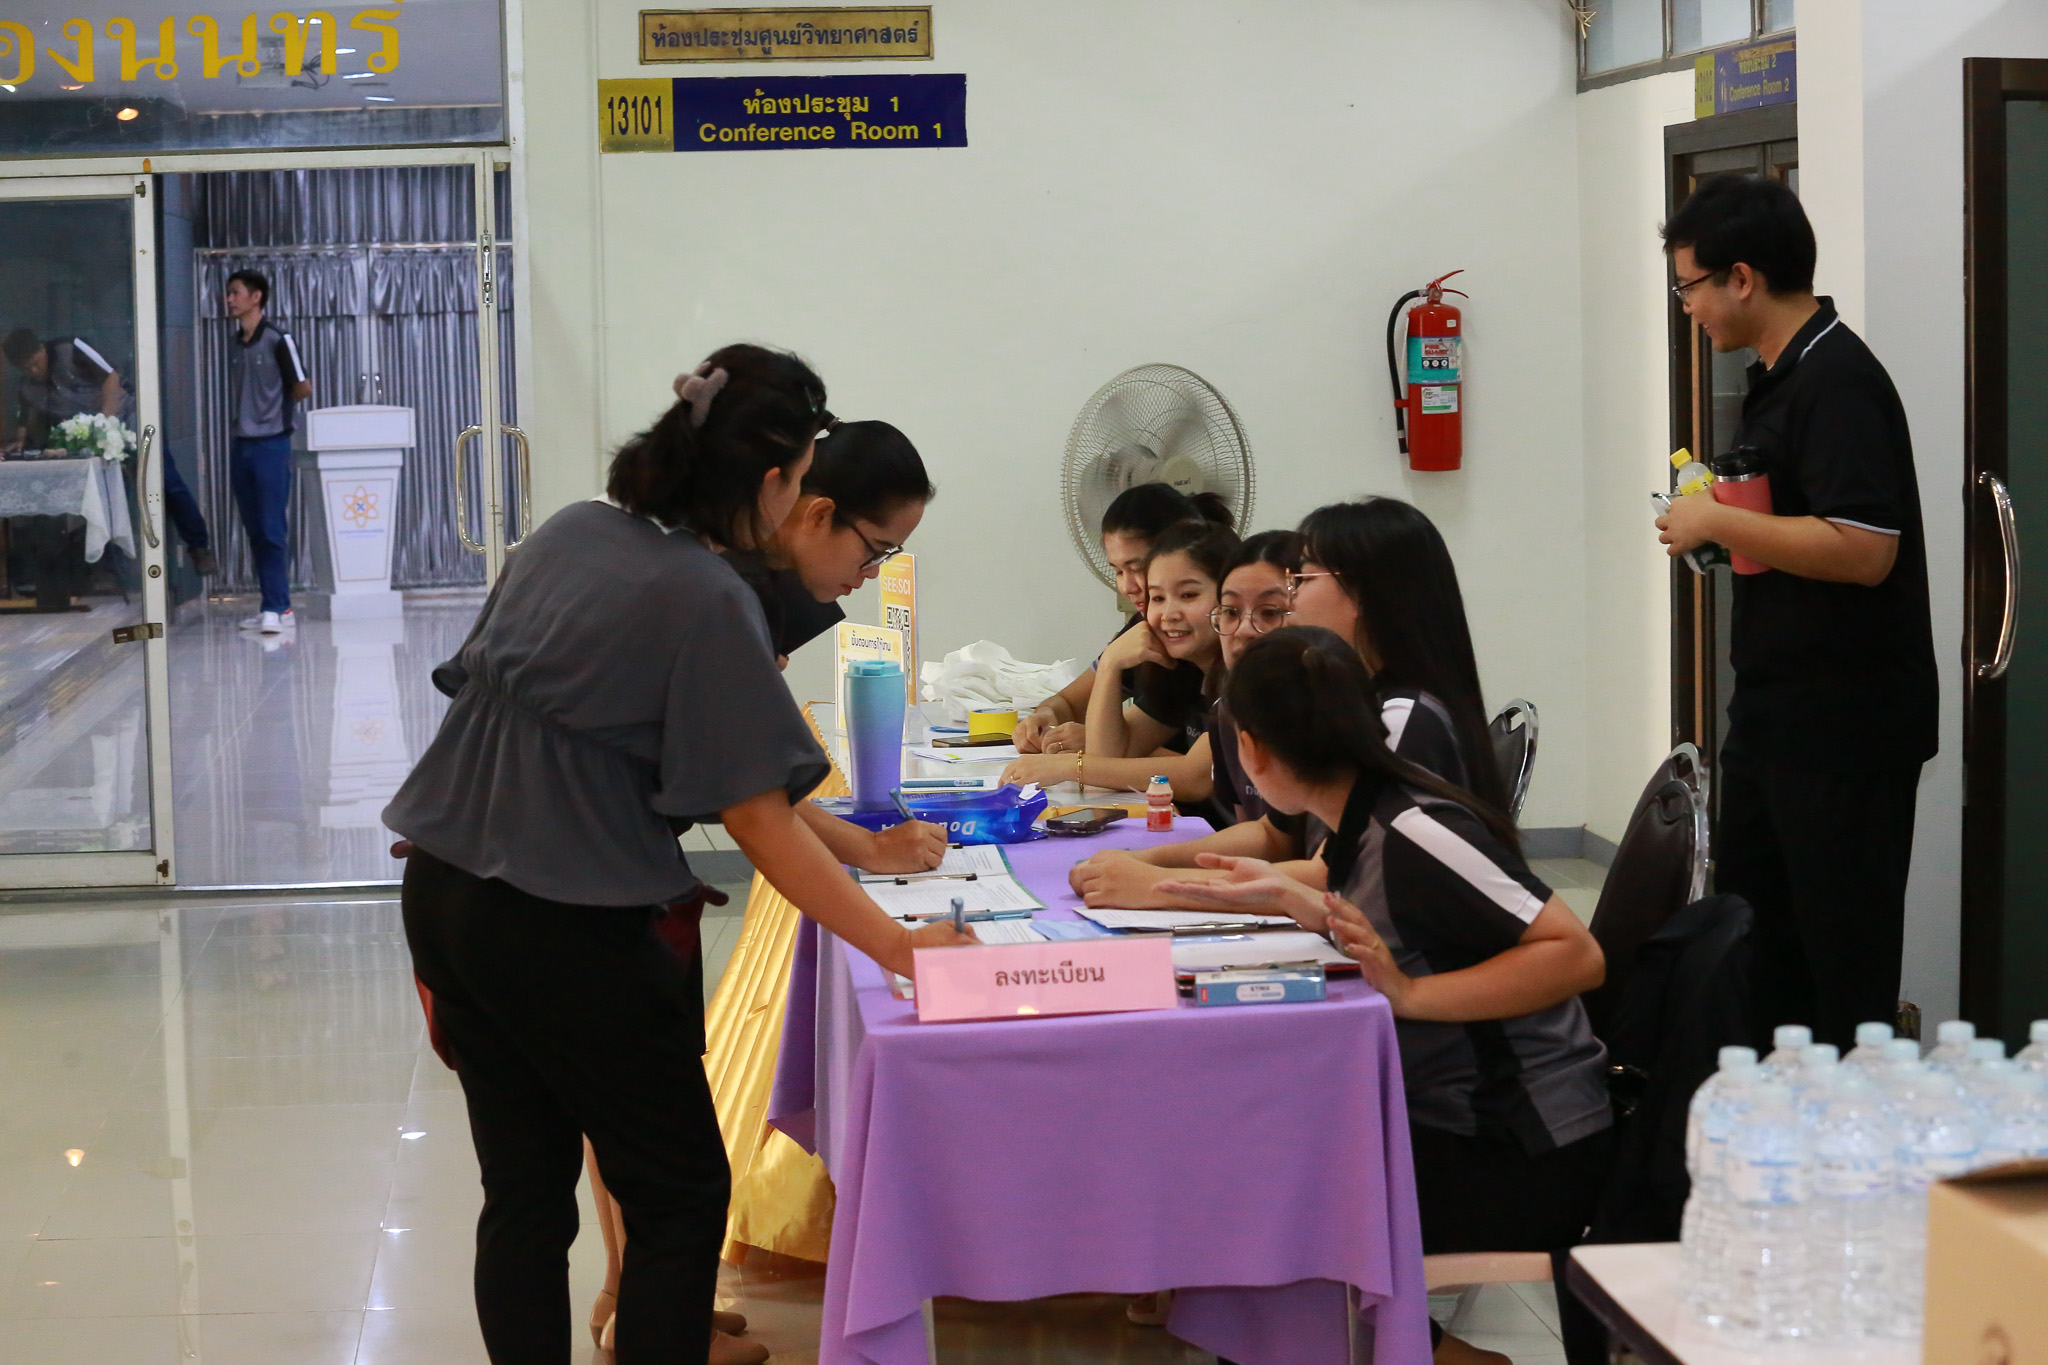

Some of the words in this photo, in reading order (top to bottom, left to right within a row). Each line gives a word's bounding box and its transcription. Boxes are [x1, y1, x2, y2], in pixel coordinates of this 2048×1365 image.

[651, 20, 920, 55] ห้องประชุมศูนย์วิทยาศาสตร์
[1784, 77, 1790, 92] 2
[607, 95, 663, 136] 13101
[742, 88, 870, 121] ห้องประชุม
[889, 96, 900, 113] 1
[699, 122, 836, 143] Conference
[850, 120, 920, 141] Room
[933, 122, 943, 139] 1
[994, 960, 1105, 988] ลงทะเบียน
